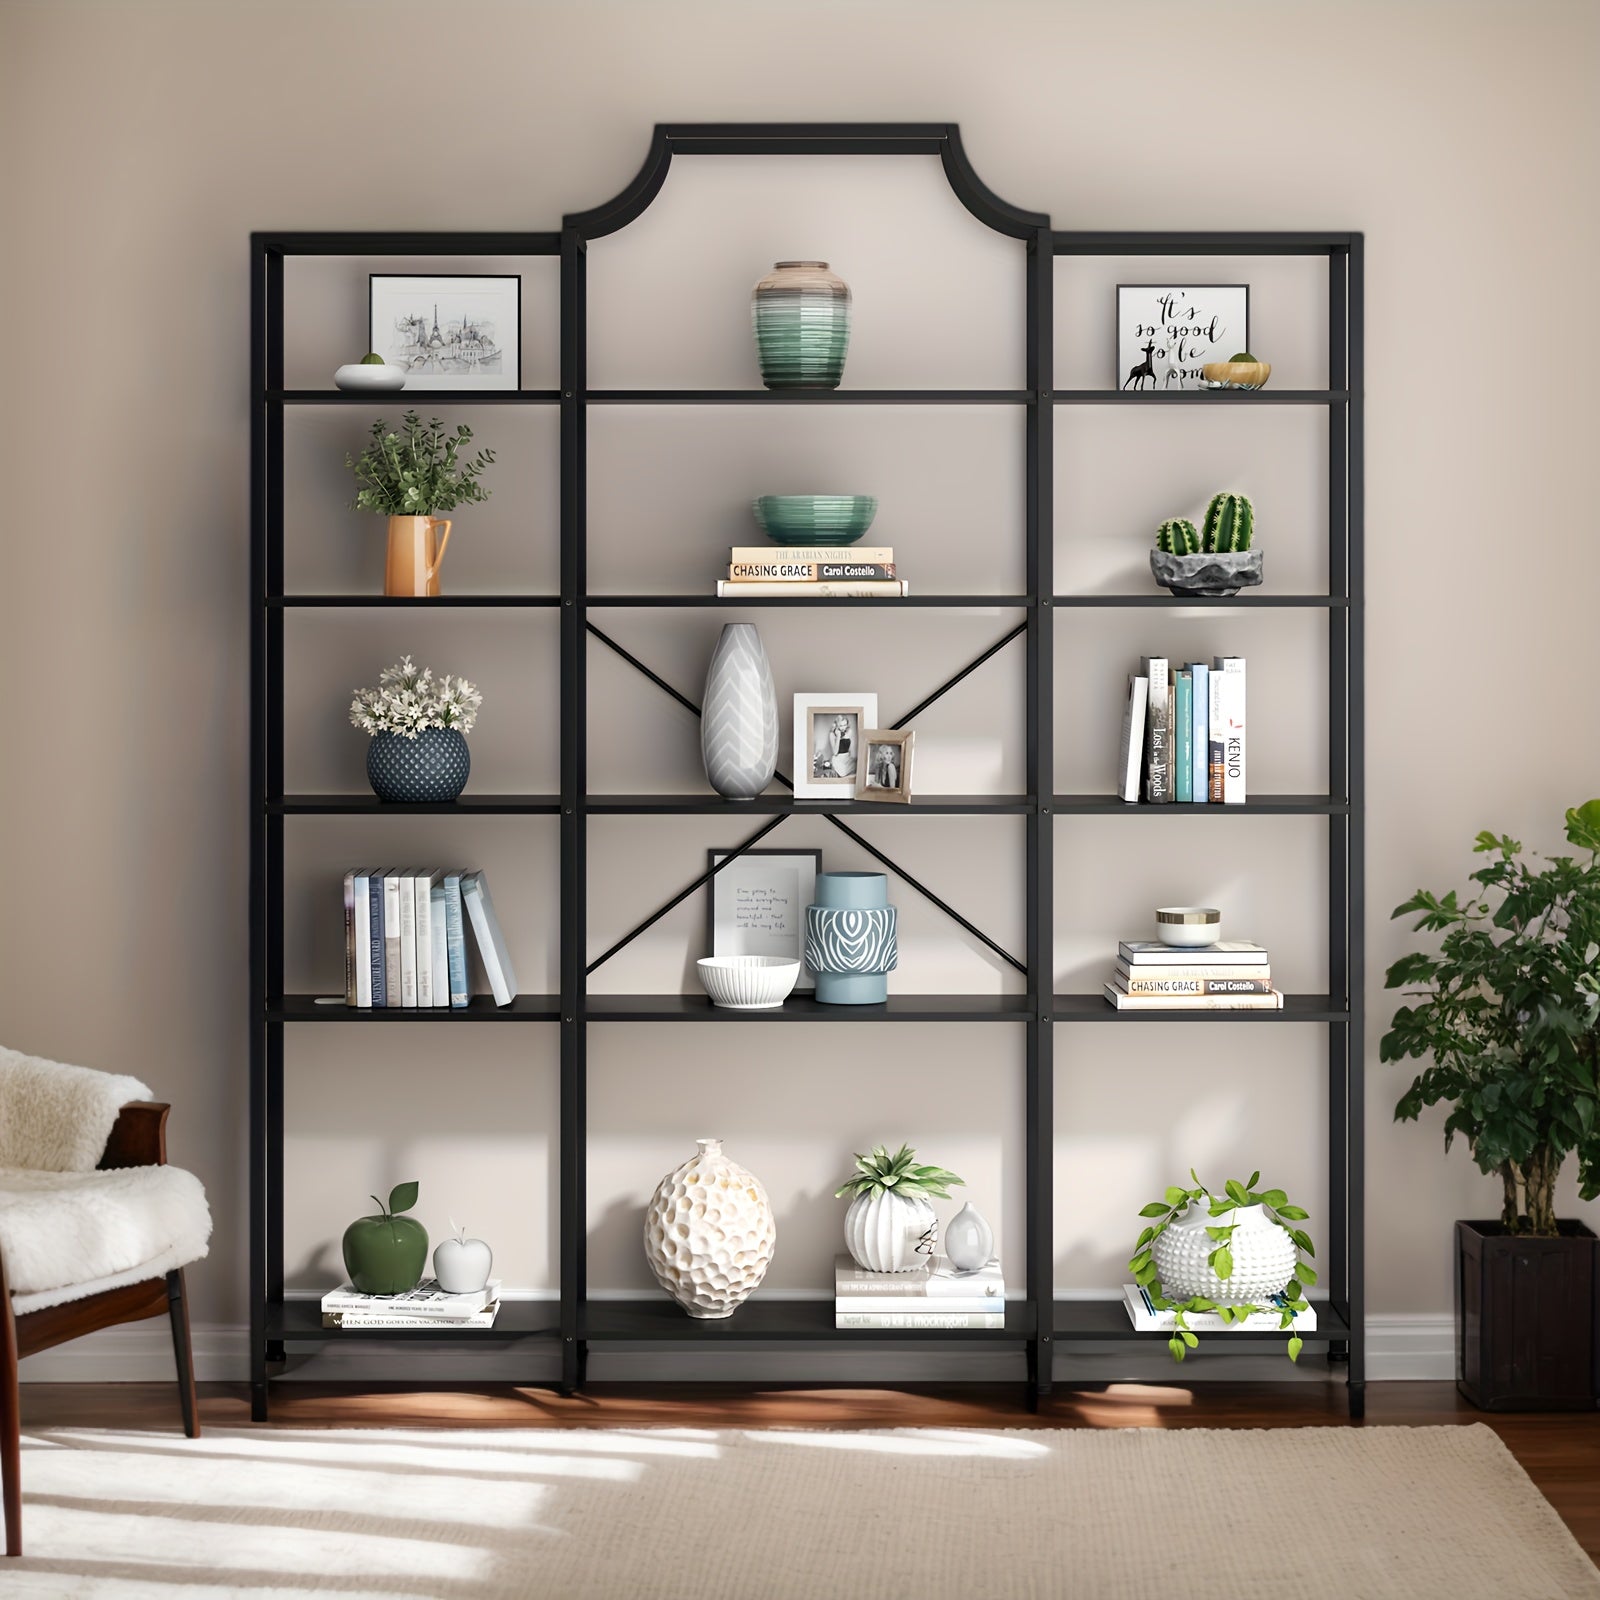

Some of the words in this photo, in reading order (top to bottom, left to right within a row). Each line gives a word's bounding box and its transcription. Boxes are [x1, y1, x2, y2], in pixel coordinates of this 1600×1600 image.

[1157, 292, 1201, 325] It's
[1135, 324, 1161, 337] so
[1167, 316, 1226, 343] good
[1178, 338, 1206, 362] be
[776, 551, 790, 561] THE
[792, 551, 823, 561] ARABIAN
[825, 551, 852, 561] NIGHTS
[734, 566, 778, 577] CHASING
[780, 566, 812, 577] GRACE
[823, 566, 844, 576] Carol
[844, 566, 875, 576] Costello
[1153, 728, 1167, 750] Lost
[1228, 738, 1240, 778] KENJO
[1153, 764, 1167, 797] Woods
[371, 938, 382, 964] INWARD
[372, 963, 382, 1003] ADVENTURE
[1131, 982, 1170, 992] CHASING
[1172, 982, 1200, 992] GRACE
[1209, 981, 1226, 991] Carol
[1227, 981, 1254, 991] Costello
